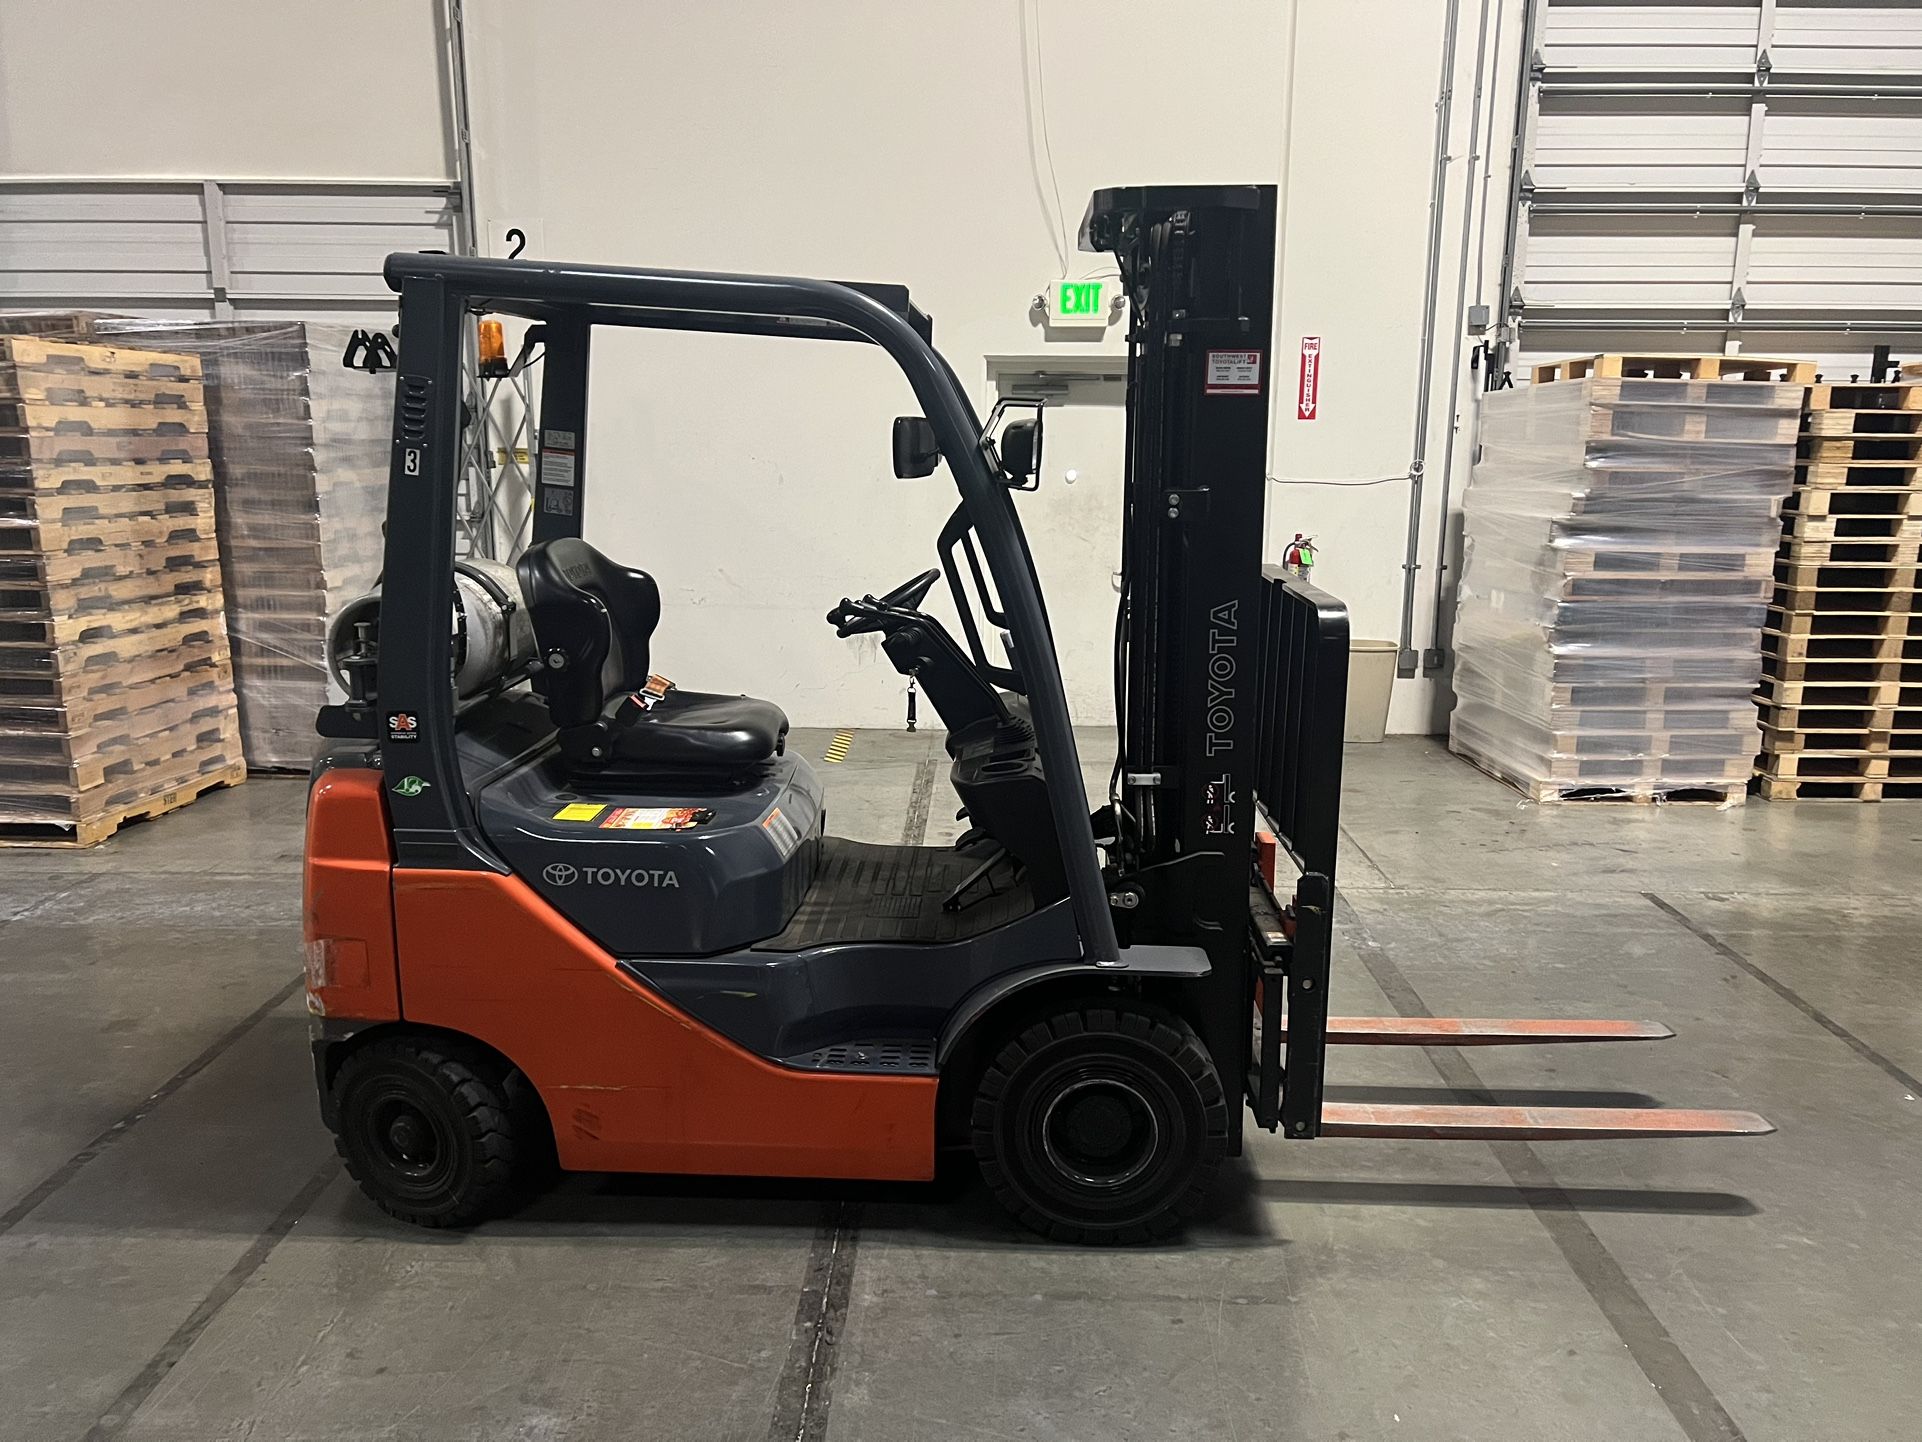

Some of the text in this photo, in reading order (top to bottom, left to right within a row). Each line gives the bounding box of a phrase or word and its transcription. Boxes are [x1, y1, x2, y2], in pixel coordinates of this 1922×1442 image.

[1061, 282, 1102, 314] EXIT
[1304, 342, 1318, 351] FIRE
[407, 450, 417, 473] 3
[1206, 599, 1239, 757] TOYOTA
[389, 714, 417, 730] SAS
[582, 867, 680, 888] TOYOTA
